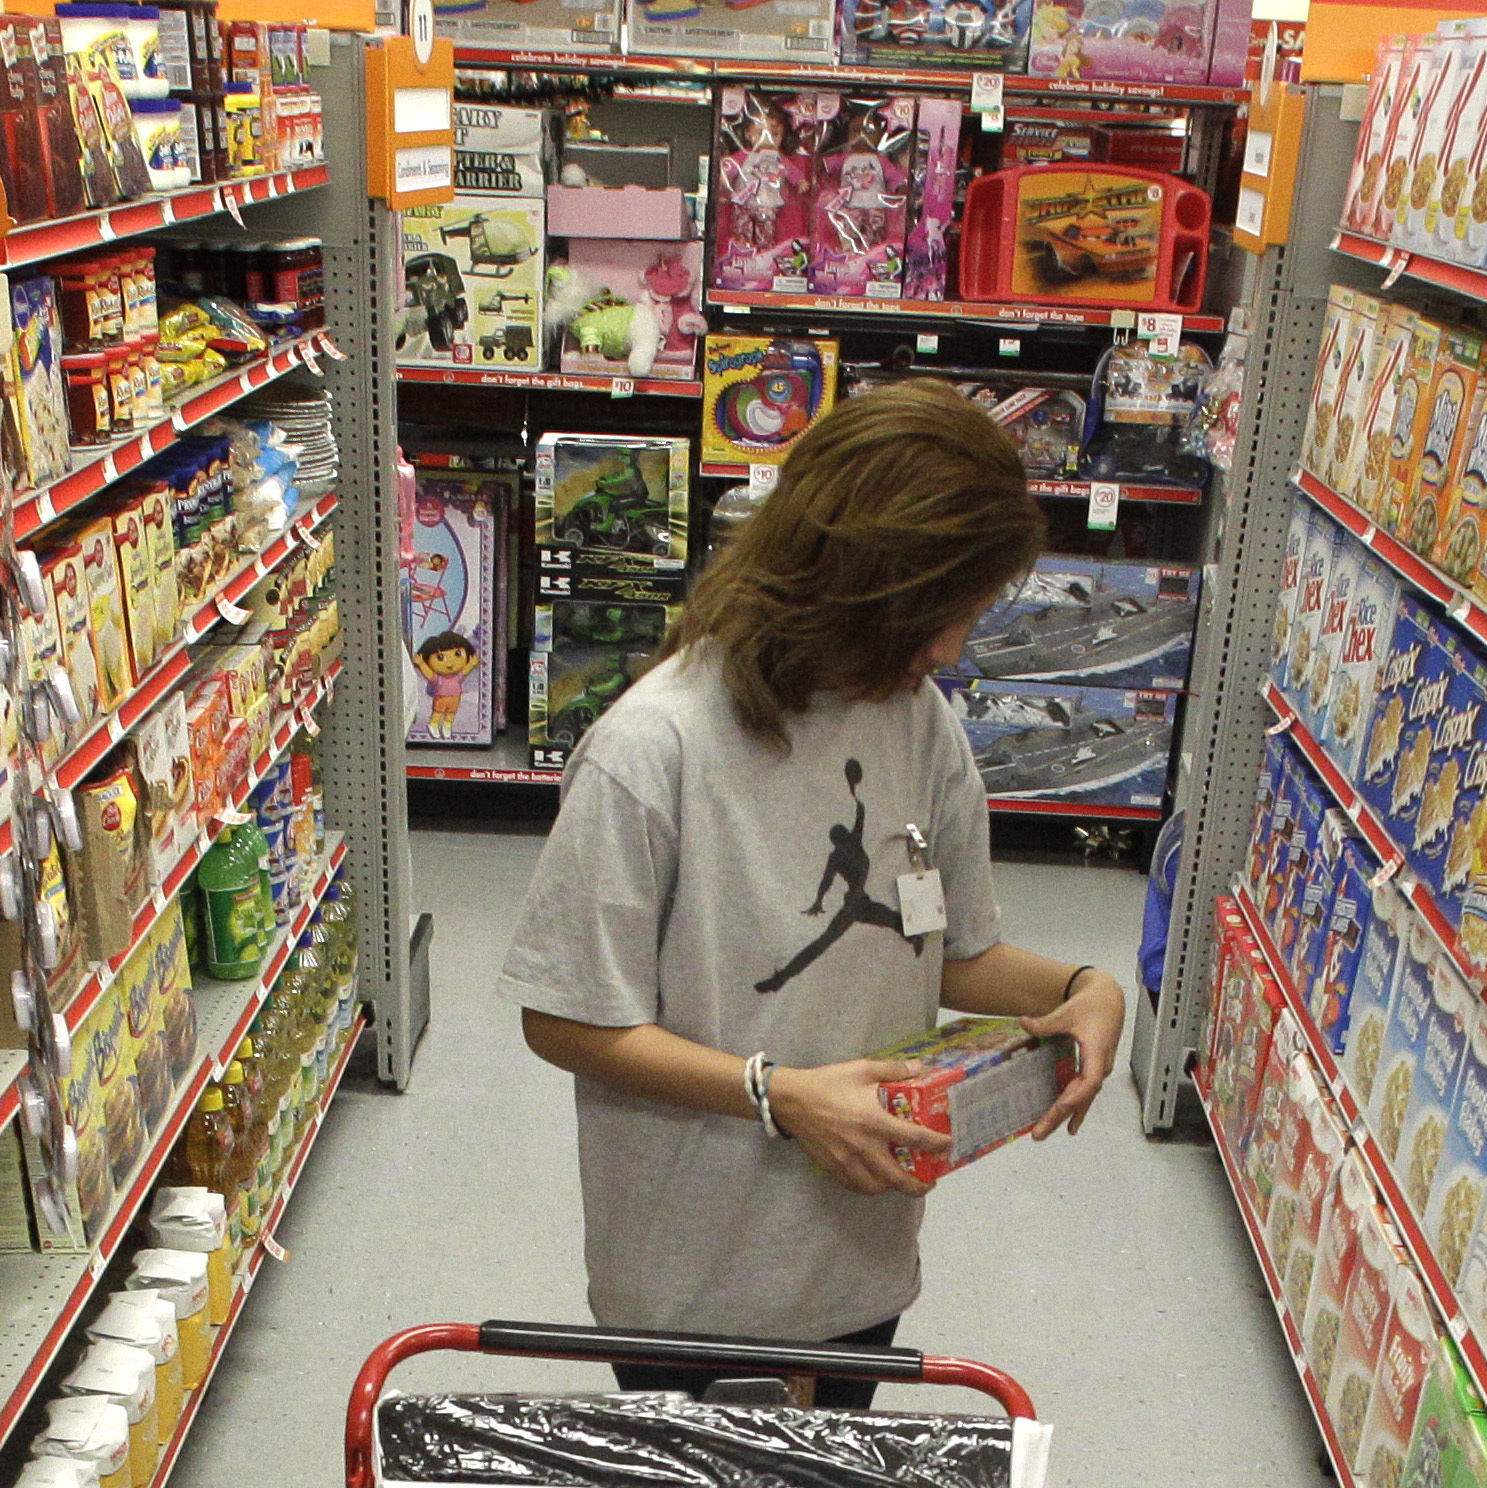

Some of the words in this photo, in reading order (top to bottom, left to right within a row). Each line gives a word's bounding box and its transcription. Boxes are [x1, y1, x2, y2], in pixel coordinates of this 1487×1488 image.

[512, 53, 553, 65] celebrate
[555, 54, 587, 66] holiday
[1049, 82, 1088, 93] celebrate
[1090, 83, 1126, 95] holiday
[531, 773, 562, 782] batterie
